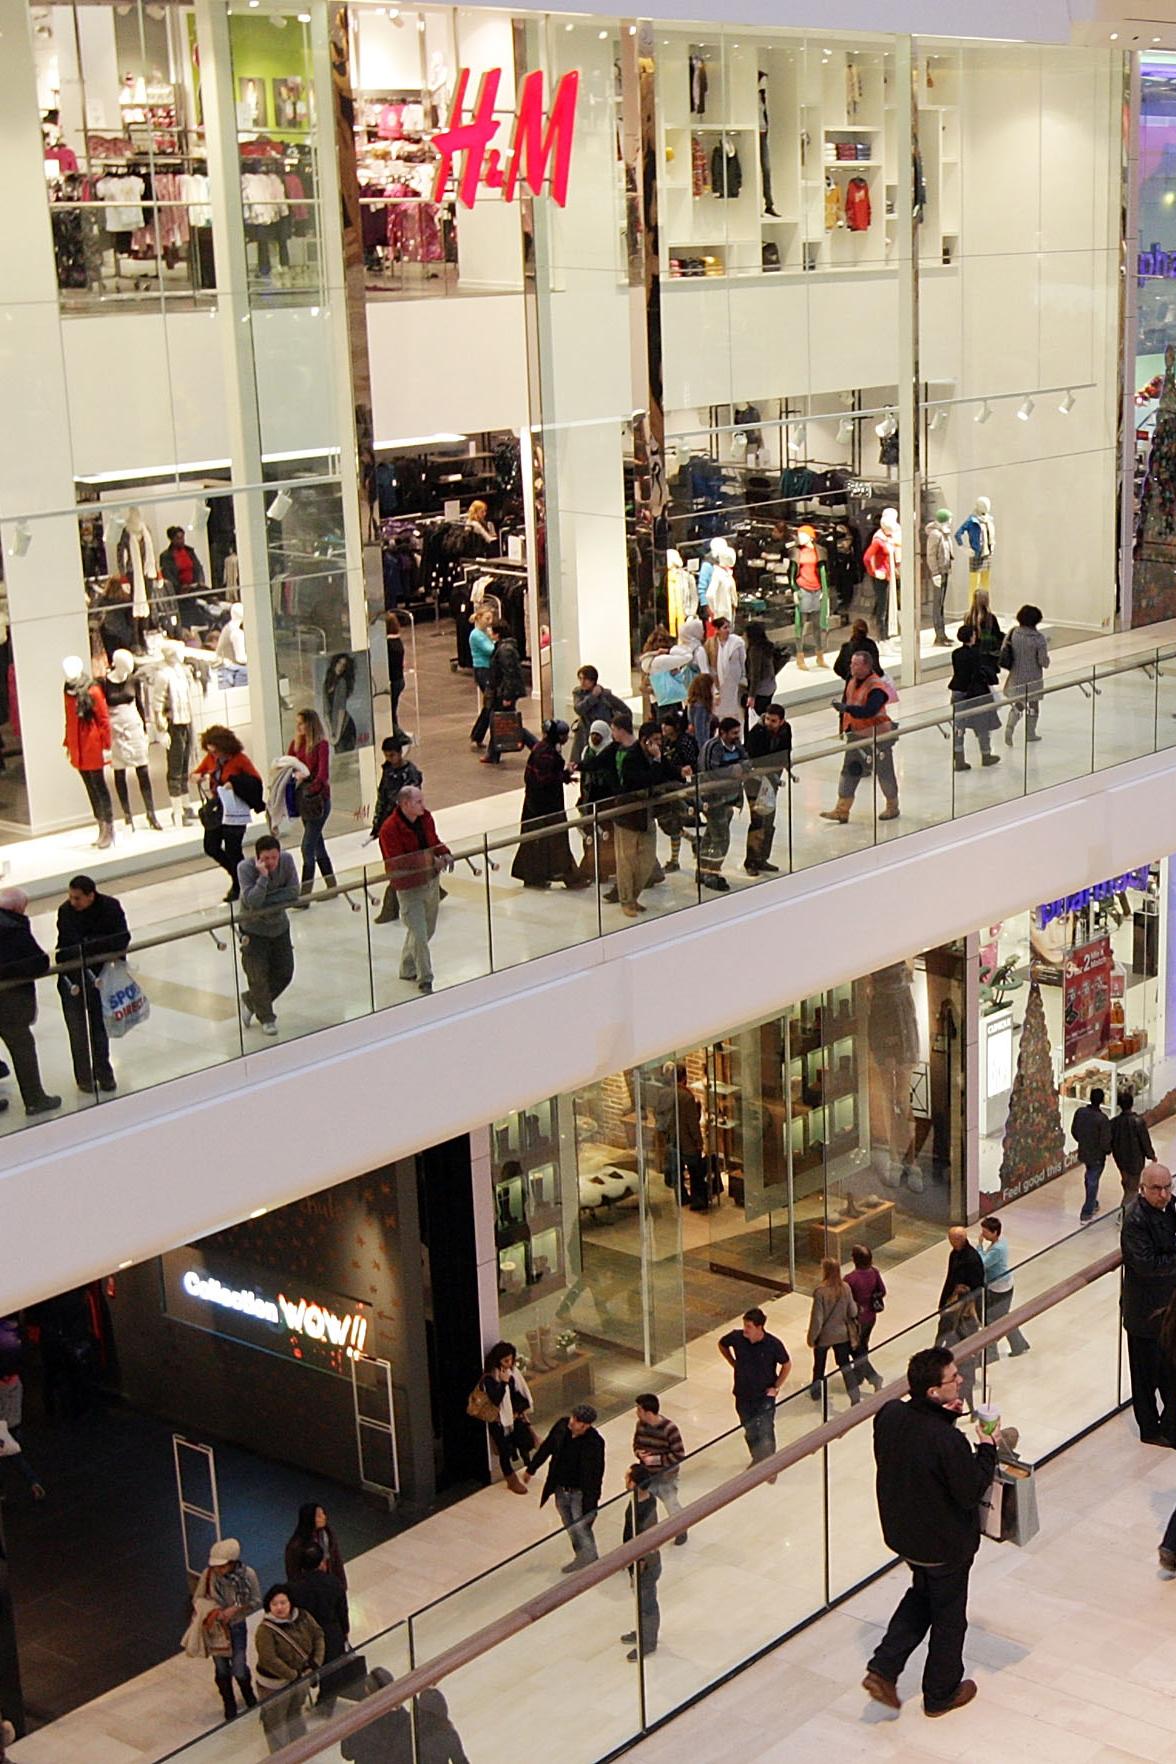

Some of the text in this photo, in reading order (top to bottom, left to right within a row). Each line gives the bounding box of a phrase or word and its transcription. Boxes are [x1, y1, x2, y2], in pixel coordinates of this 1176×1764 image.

[431, 67, 582, 210] H&M
[1066, 960, 1074, 979] 3
[1083, 954, 1091, 973] 2
[1003, 1181, 1021, 1201] Feel
[1023, 1168, 1046, 1193] good
[1046, 1161, 1062, 1178] this
[182, 1270, 280, 1324] Collection
